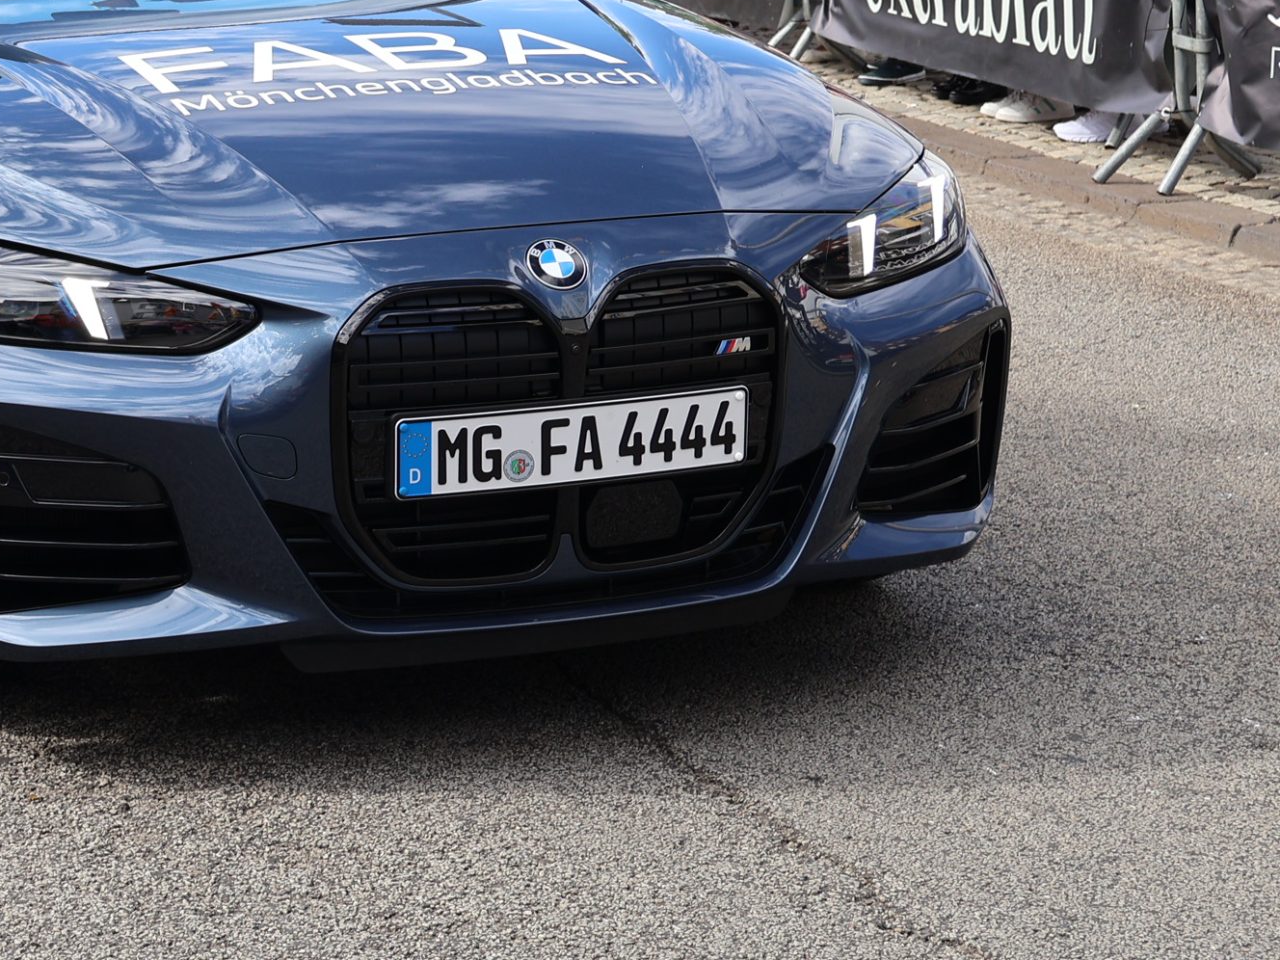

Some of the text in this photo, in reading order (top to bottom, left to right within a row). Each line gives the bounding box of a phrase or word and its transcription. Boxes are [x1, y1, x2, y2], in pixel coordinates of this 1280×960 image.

[117, 28, 628, 94] FABA
[169, 67, 659, 117] Mönchengladbach
[438, 401, 737, 486] MG FA 4444
[409, 468, 421, 485] D
